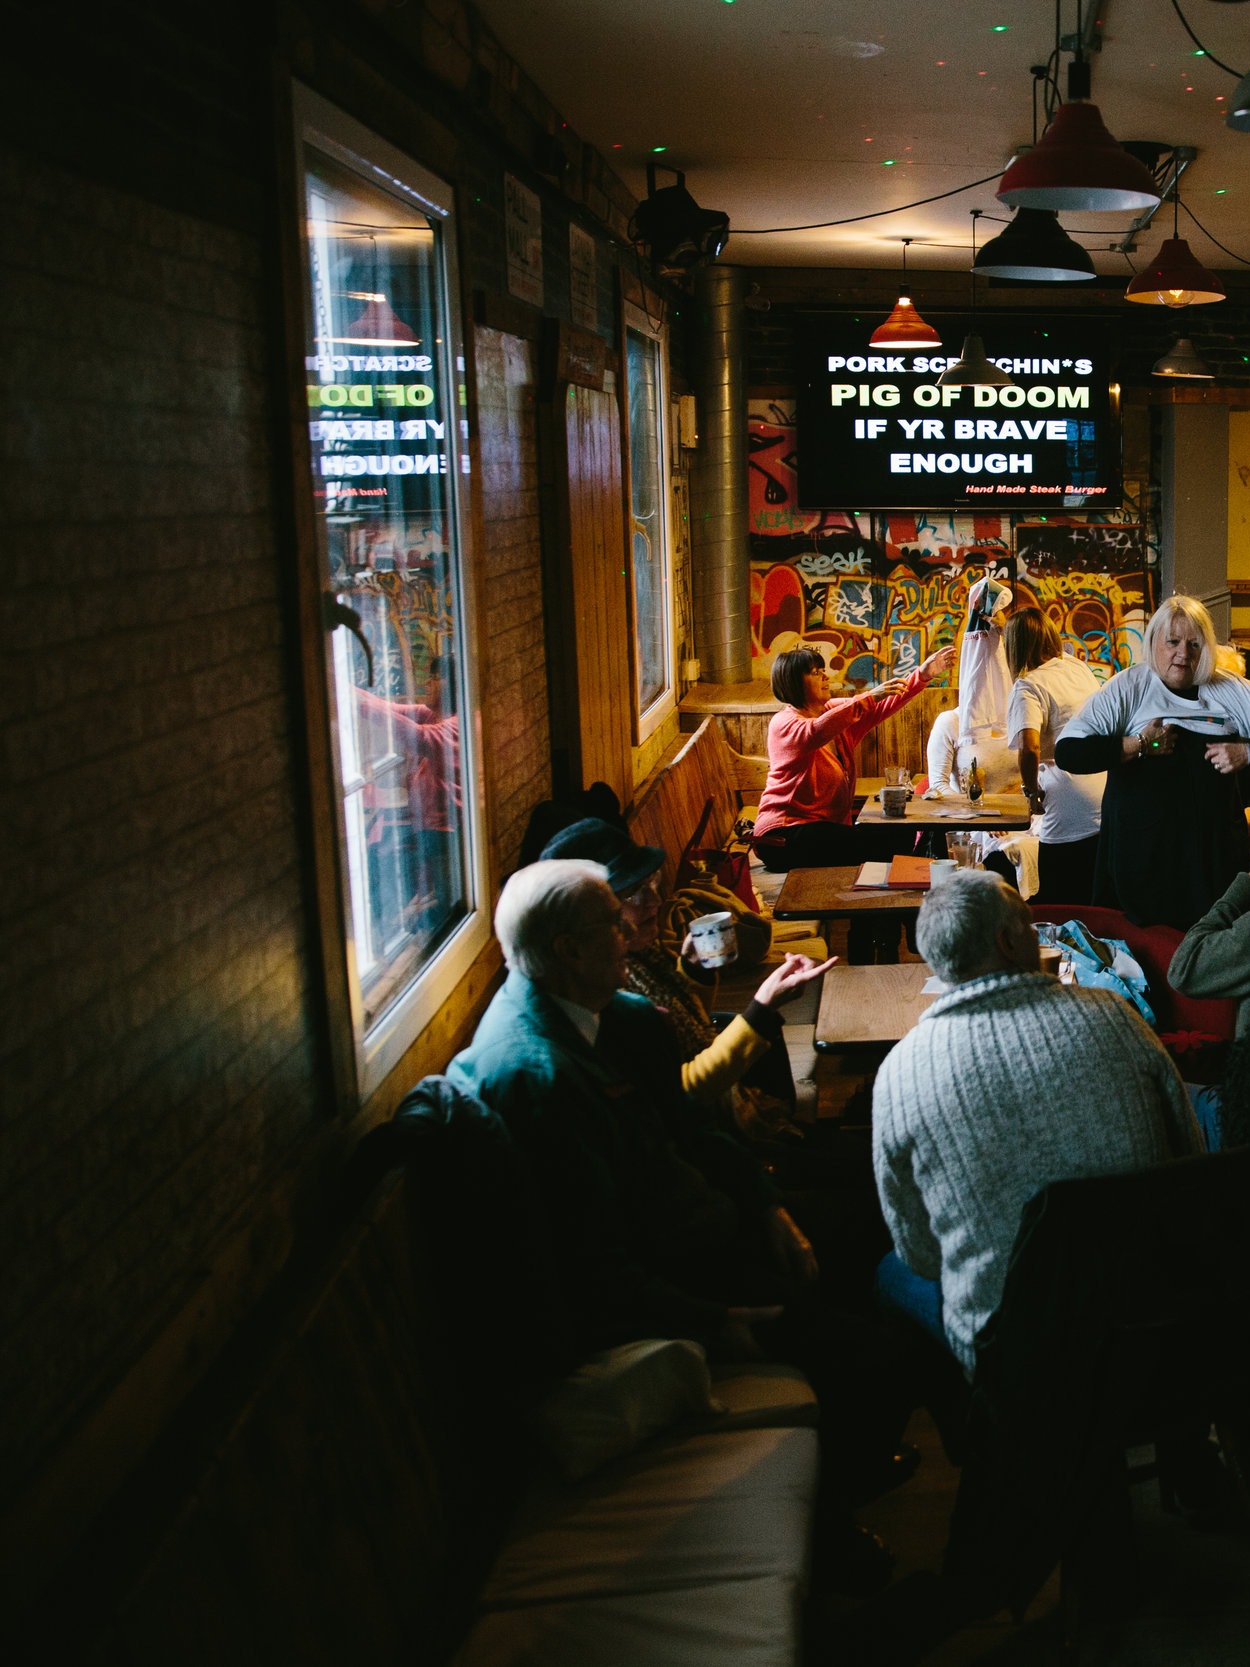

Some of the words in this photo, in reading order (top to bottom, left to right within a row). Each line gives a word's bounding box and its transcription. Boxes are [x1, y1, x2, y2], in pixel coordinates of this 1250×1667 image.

[828, 356, 906, 373] PORK
[912, 356, 1094, 375] SCRCHINS
[831, 384, 901, 407] PIG
[913, 385, 962, 408] OF
[973, 385, 1090, 409] DOOM
[854, 419, 888, 439] IF
[897, 419, 945, 440] YR
[954, 420, 1068, 440] BRAVE
[890, 453, 1034, 474] ENOUGH
[966, 485, 995, 494] Hand
[996, 485, 1027, 494] Made
[1029, 485, 1062, 494] Steak
[1064, 486, 1108, 496] Burger
